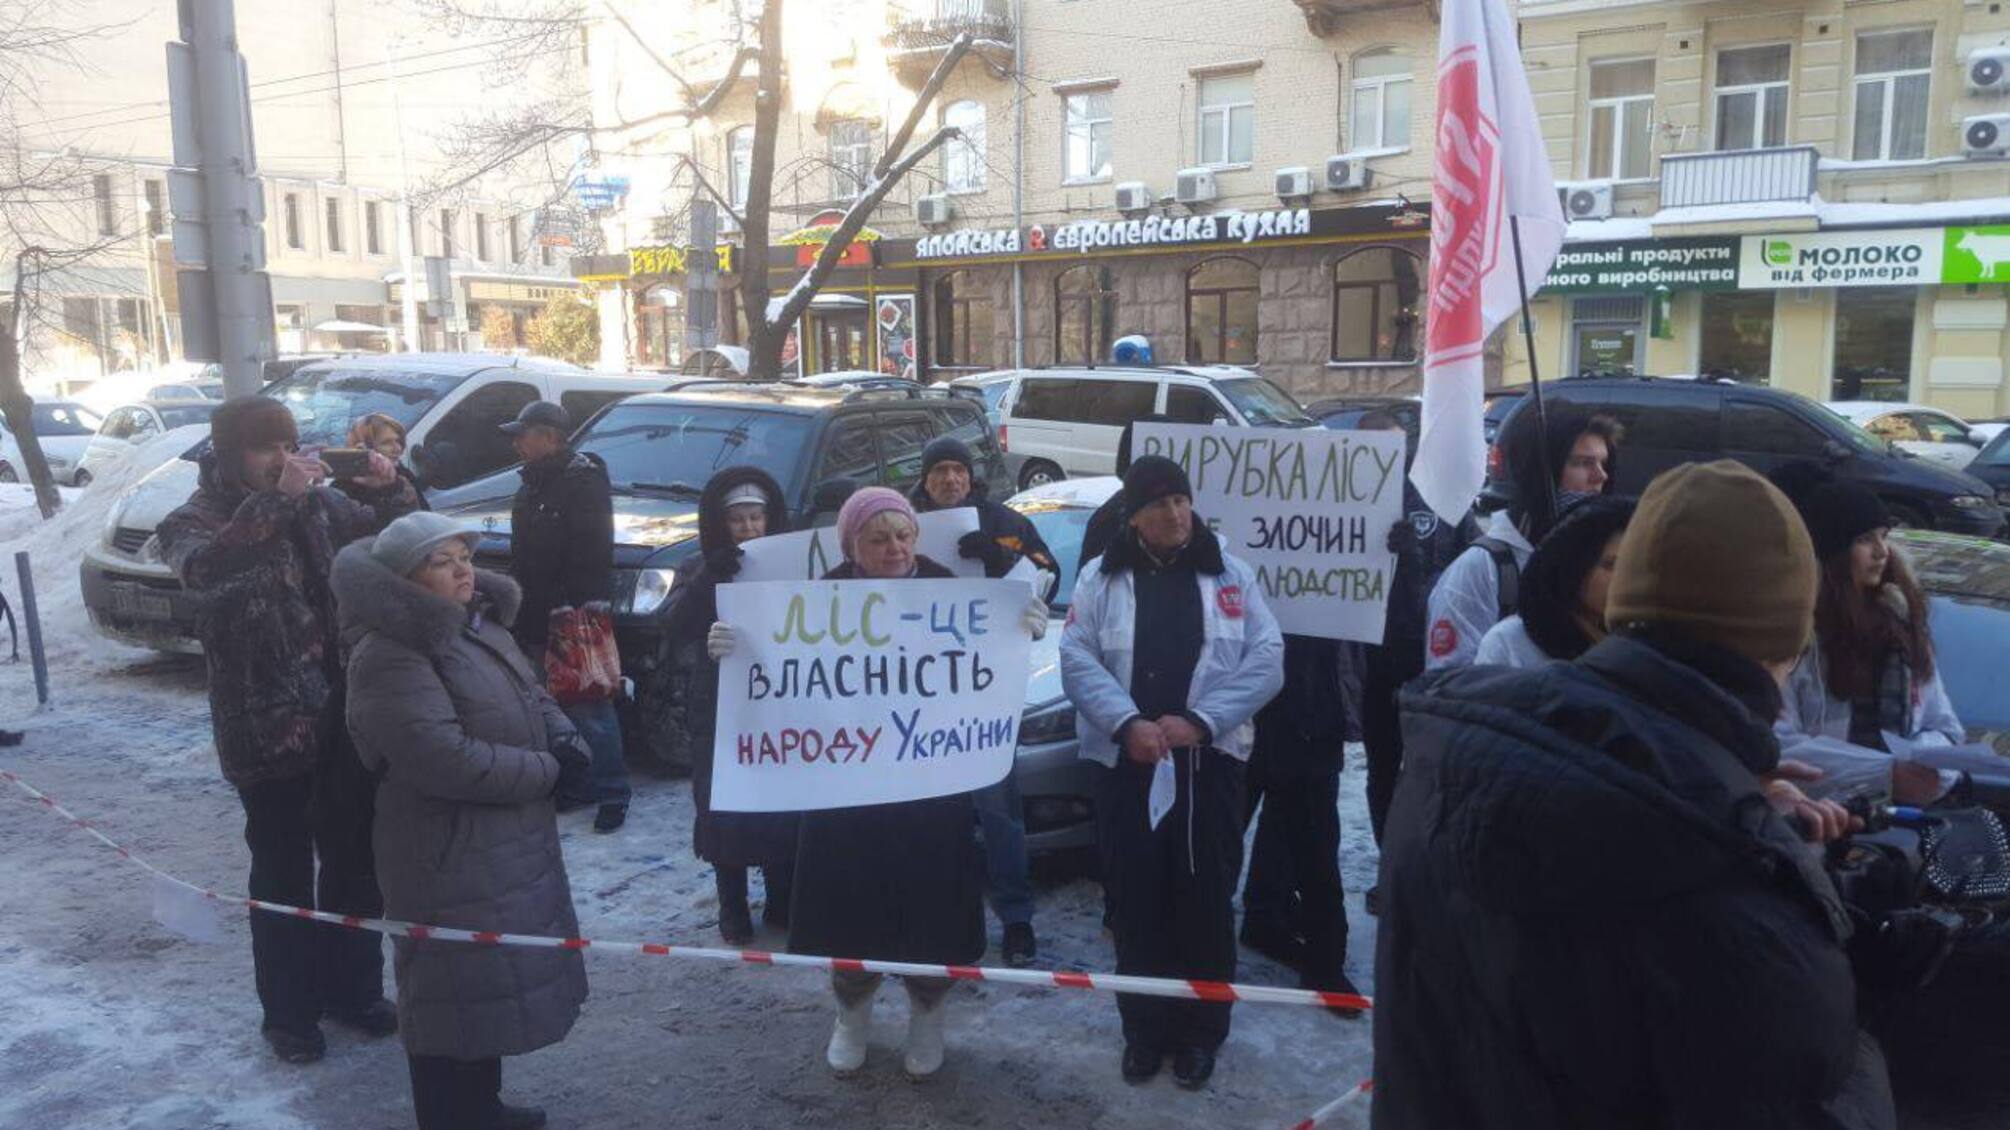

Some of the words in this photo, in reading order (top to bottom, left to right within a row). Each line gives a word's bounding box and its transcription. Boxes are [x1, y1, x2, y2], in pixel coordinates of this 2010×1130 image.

[1630, 247, 1731, 267] продукти
[1541, 271, 1592, 286] ного
[1598, 267, 1735, 288] виробництва
[1771, 270, 1804, 282] від
[1811, 266, 1919, 283] фермера
[1246, 515, 1367, 554] ЗЛОЧИН
[1256, 564, 1384, 601] ЛЮДСТВА
[737, 726, 882, 765] НАРОДУ
